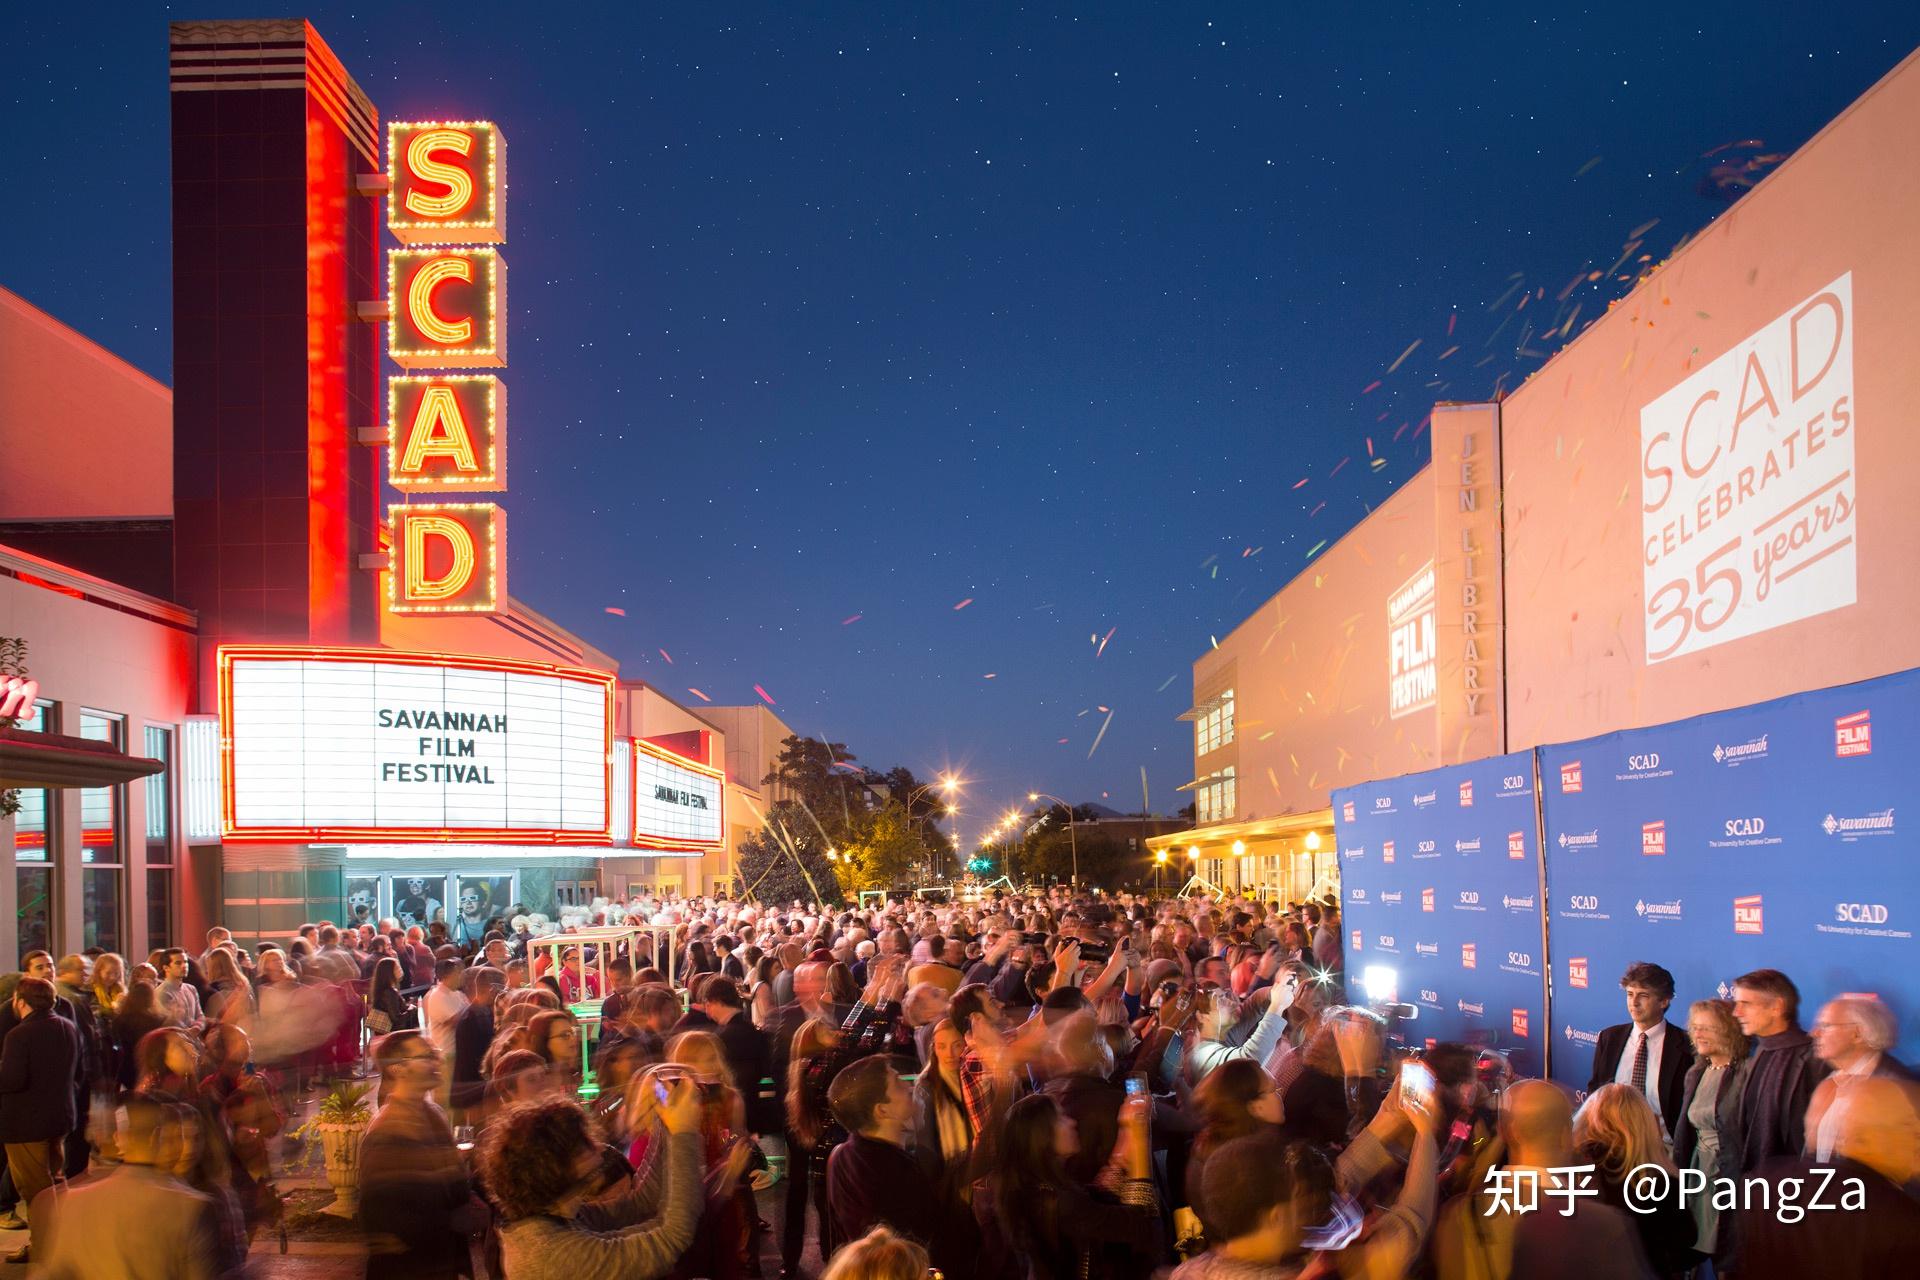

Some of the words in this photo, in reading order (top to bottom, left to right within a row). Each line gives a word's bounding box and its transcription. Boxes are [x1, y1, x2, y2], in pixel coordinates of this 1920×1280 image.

[401, 129, 480, 601] SCAD
[1643, 292, 1844, 513] SCAD
[1459, 434, 1478, 512] JEN
[1644, 395, 1851, 567] CELEBRATES
[1648, 536, 1742, 660] 35
[1752, 490, 1856, 602] years
[1462, 528, 1480, 717] LIBRARY
[1392, 662, 1437, 710] FESTIVA
[378, 709, 508, 733] SAVANNAH
[1837, 726, 1868, 744] FILM
[419, 737, 475, 757] FILM
[1838, 741, 1870, 754] FESTIVAL
[1629, 753, 1659, 770] SCAD
[382, 762, 494, 784] FESTIVAL
[1562, 771, 1581, 784] FILM
[1503, 775, 1523, 789] SCAD
[1376, 797, 1392, 808] SCAD
[1725, 817, 1764, 836] SCAD
[1418, 840, 1435, 852] SCAD
[1643, 832, 1664, 845] FILM
[1460, 891, 1479, 904] SCAD
[1571, 896, 1598, 910] SCAD
[1735, 908, 1761, 922] FILM
[1836, 903, 1888, 924] SCAD
[1380, 935, 1394, 947] SCAD
[1508, 951, 1530, 966] SCAD
[1570, 966, 1586, 979] FILM
[1421, 990, 1437, 1002] SCAD
